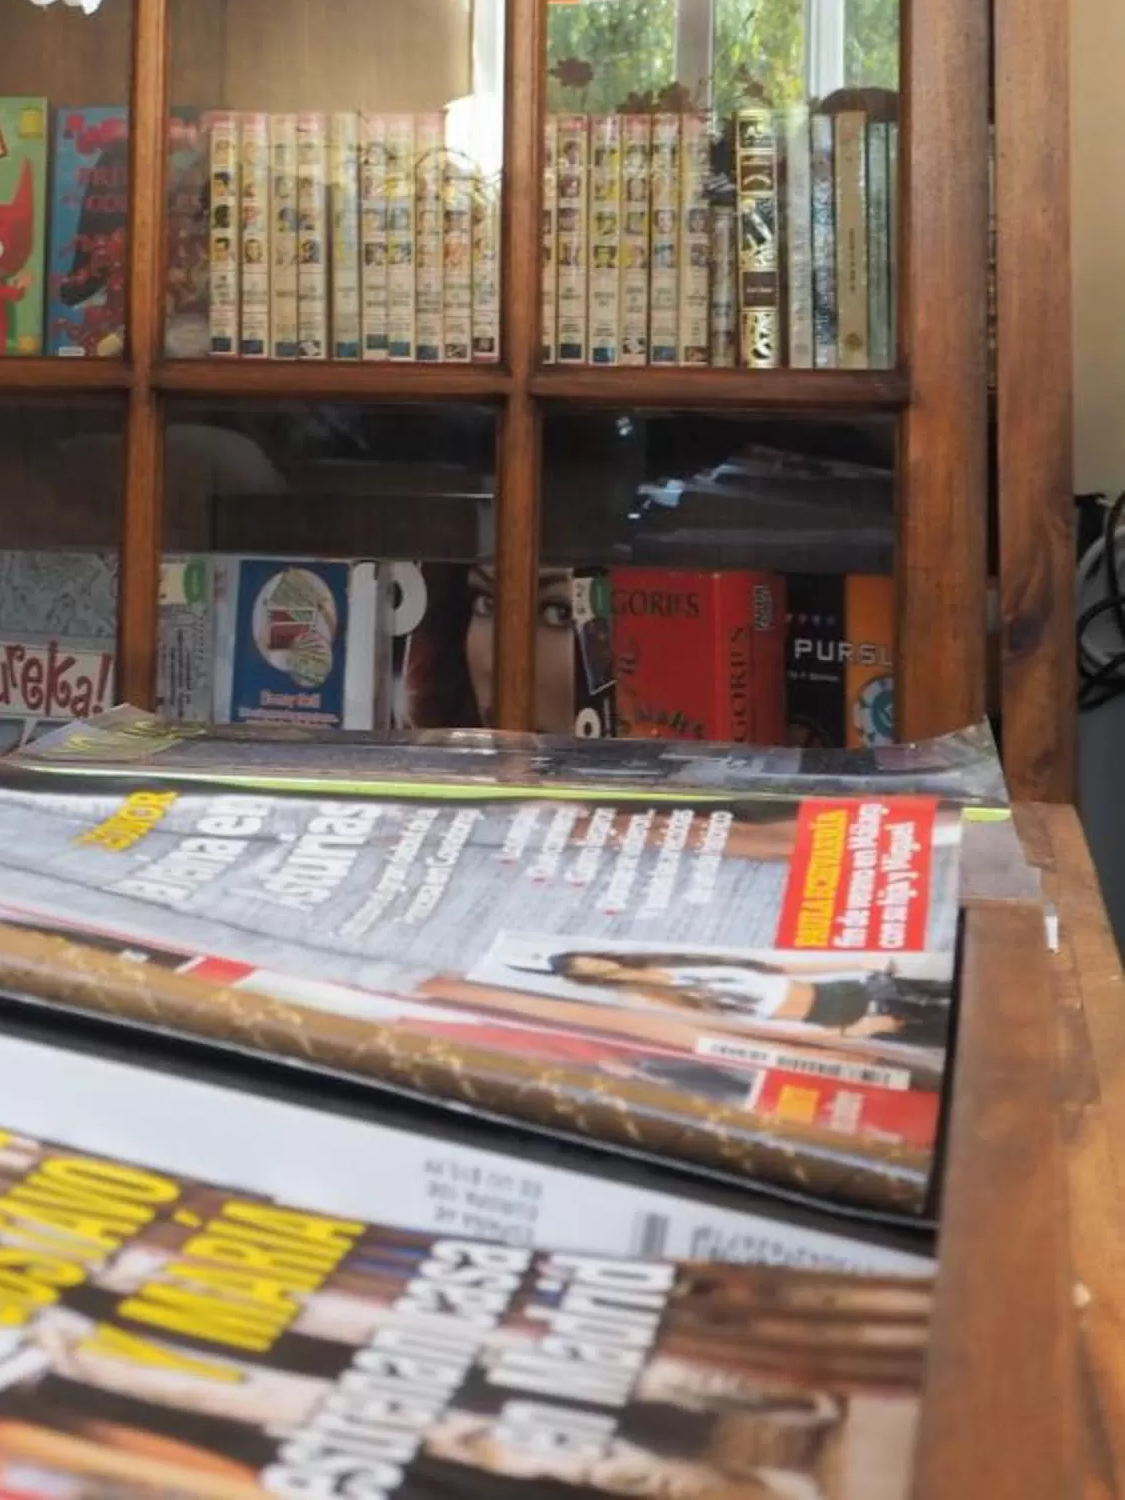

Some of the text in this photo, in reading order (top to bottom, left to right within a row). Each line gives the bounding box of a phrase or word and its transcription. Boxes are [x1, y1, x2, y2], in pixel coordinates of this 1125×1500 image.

[118, 1201, 368, 1354] MARÍA
[392, 1238, 533, 1331] casa
[486, 1252, 677, 1407] Madrid
